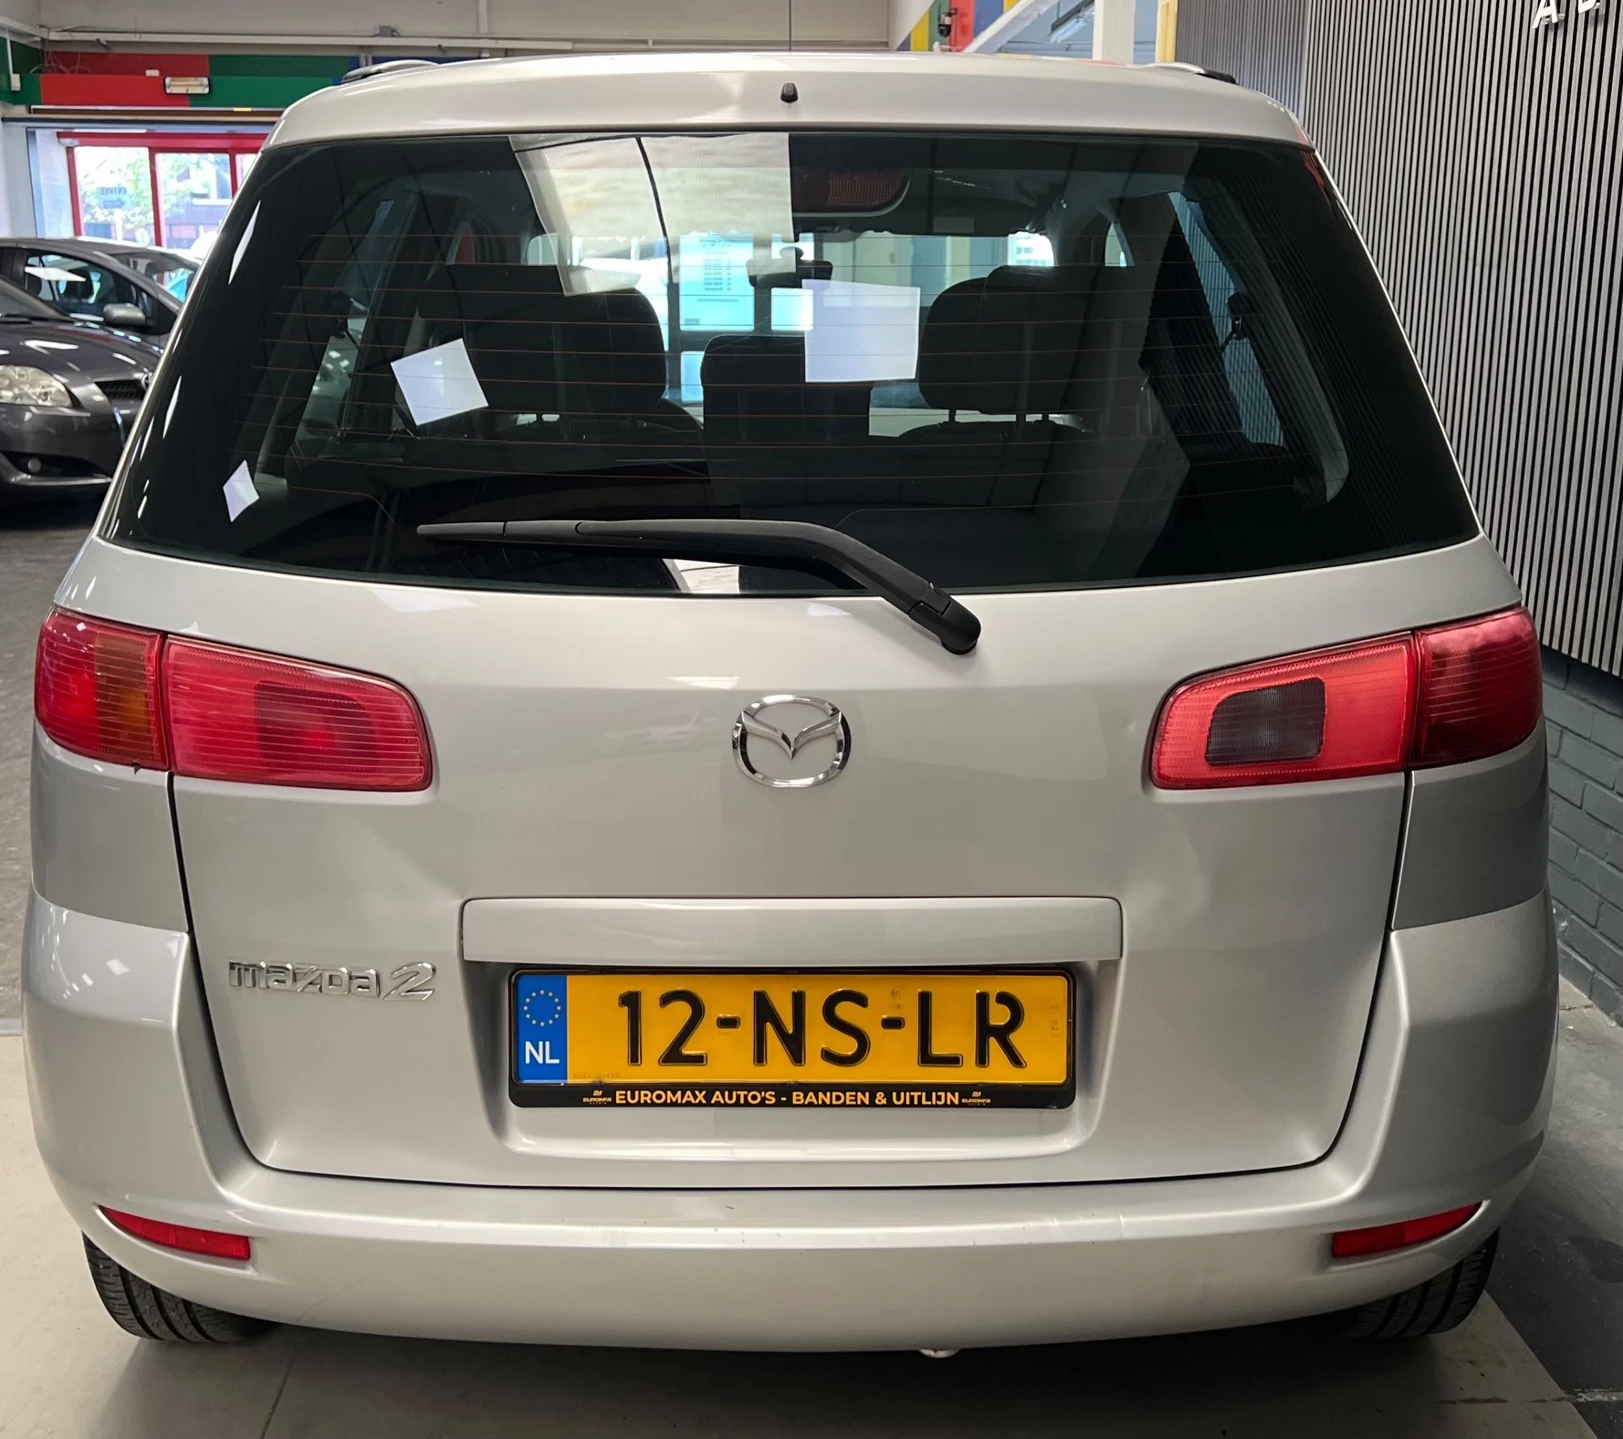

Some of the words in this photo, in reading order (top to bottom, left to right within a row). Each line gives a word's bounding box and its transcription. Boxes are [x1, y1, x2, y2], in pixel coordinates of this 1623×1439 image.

[382, 961, 437, 1001] 2
[617, 987, 1028, 1069] 12-NS-LR
[524, 1040, 560, 1065] NL
[615, 1090, 707, 1105] EUROMAX
[710, 1090, 777, 1105] AUTO'S
[792, 1091, 870, 1105] BANDEN
[874, 1091, 888, 1106] &
[892, 1091, 959, 1105] UITLIJN
